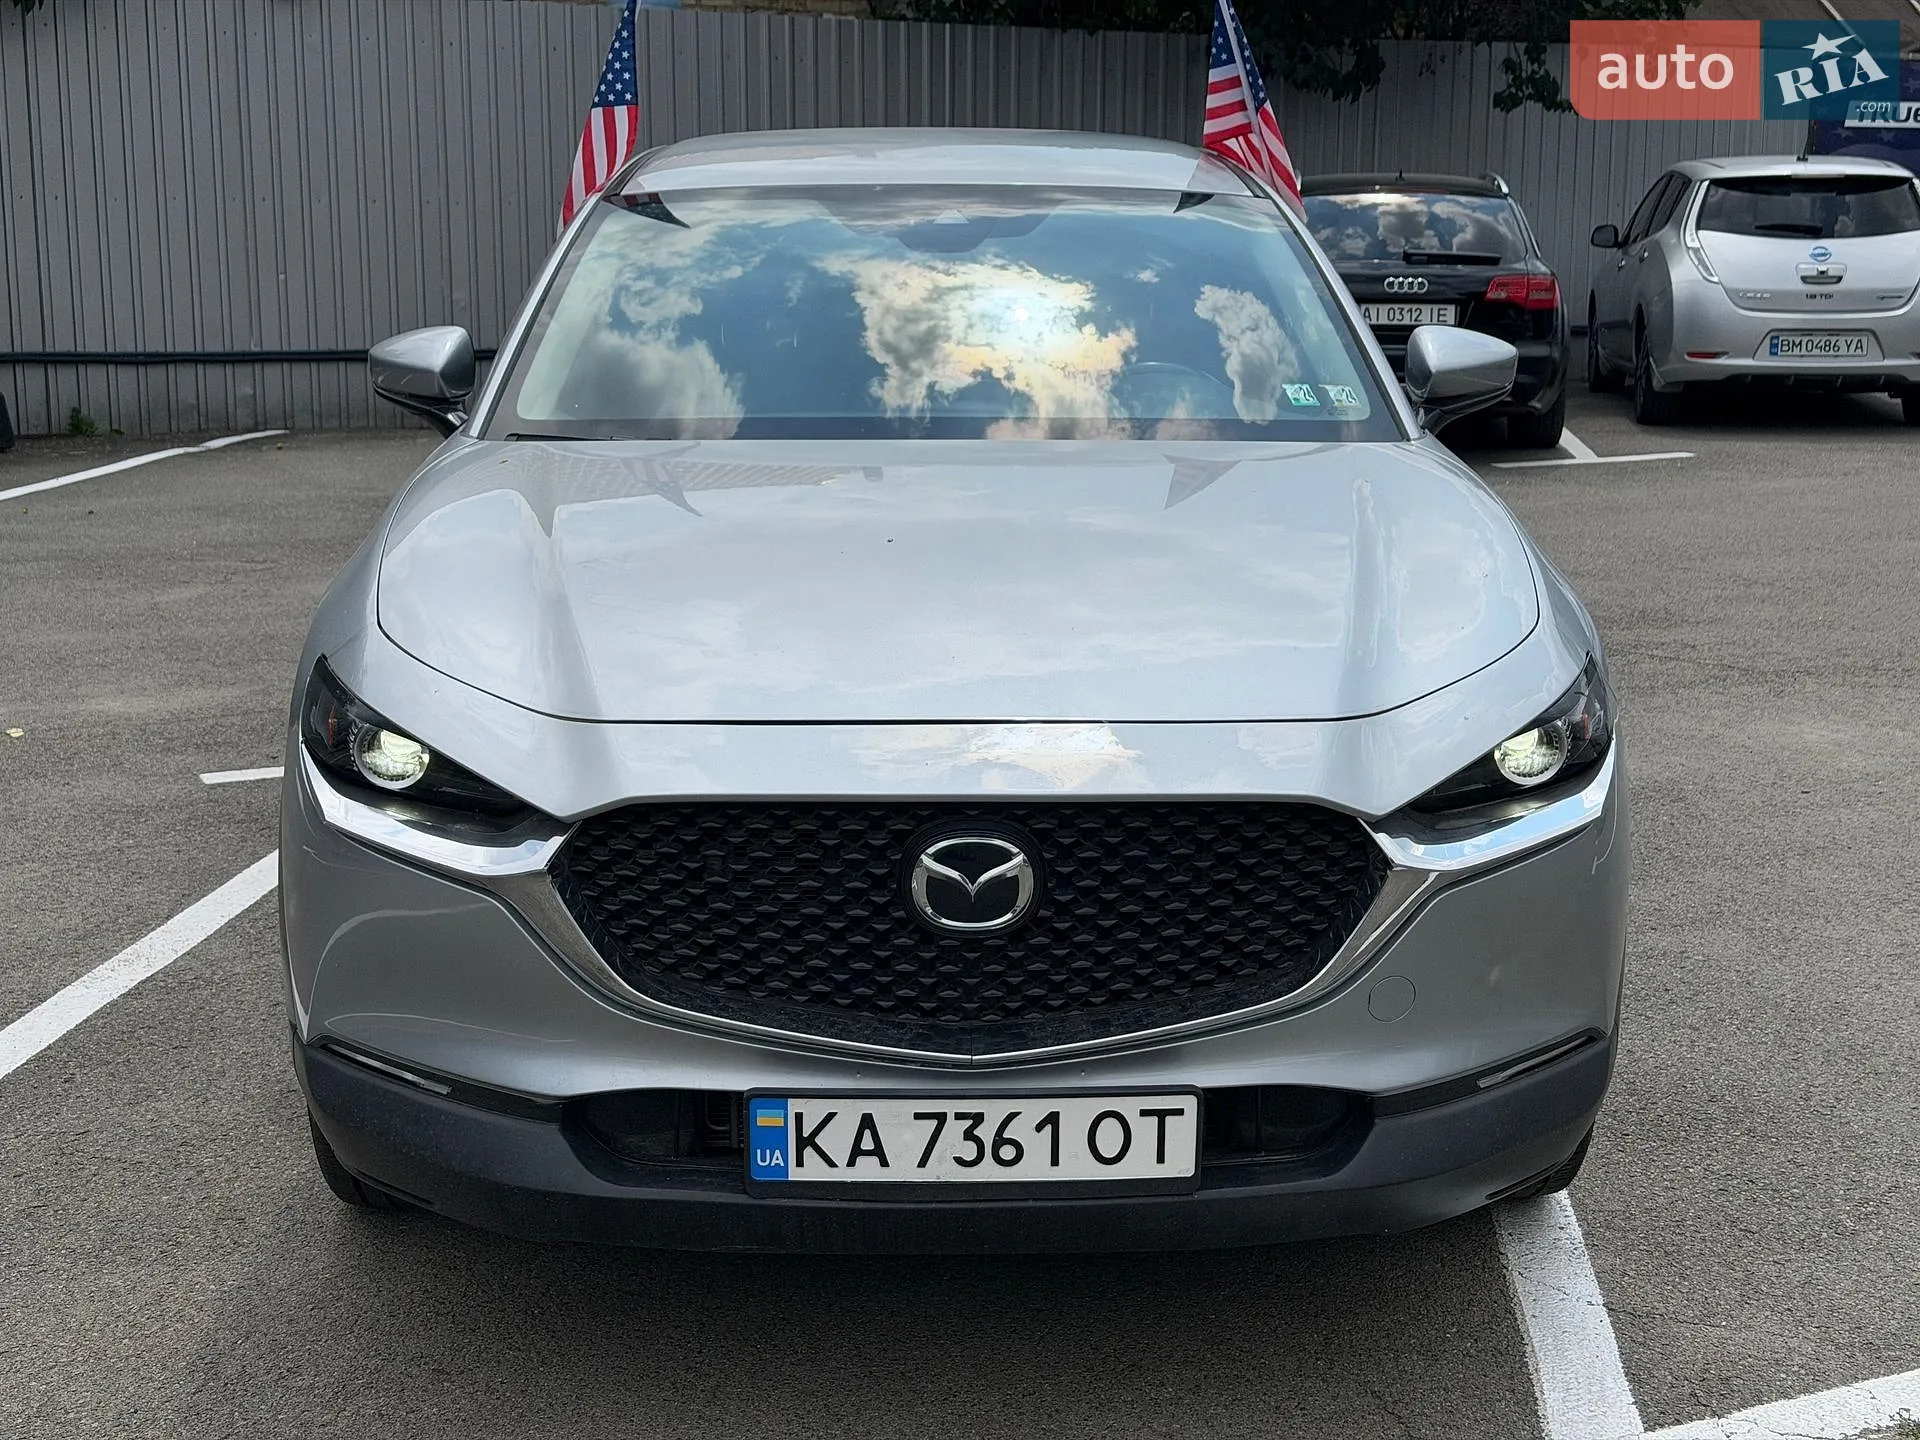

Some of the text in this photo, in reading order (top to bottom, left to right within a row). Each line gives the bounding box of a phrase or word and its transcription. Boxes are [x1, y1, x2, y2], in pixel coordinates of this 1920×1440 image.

[1363, 307, 1448, 322] AI 0312 IE
[1780, 339, 1864, 353] BM 0486 YA
[794, 1107, 1185, 1168] KA 7361 OT
[756, 1149, 785, 1167] UA
